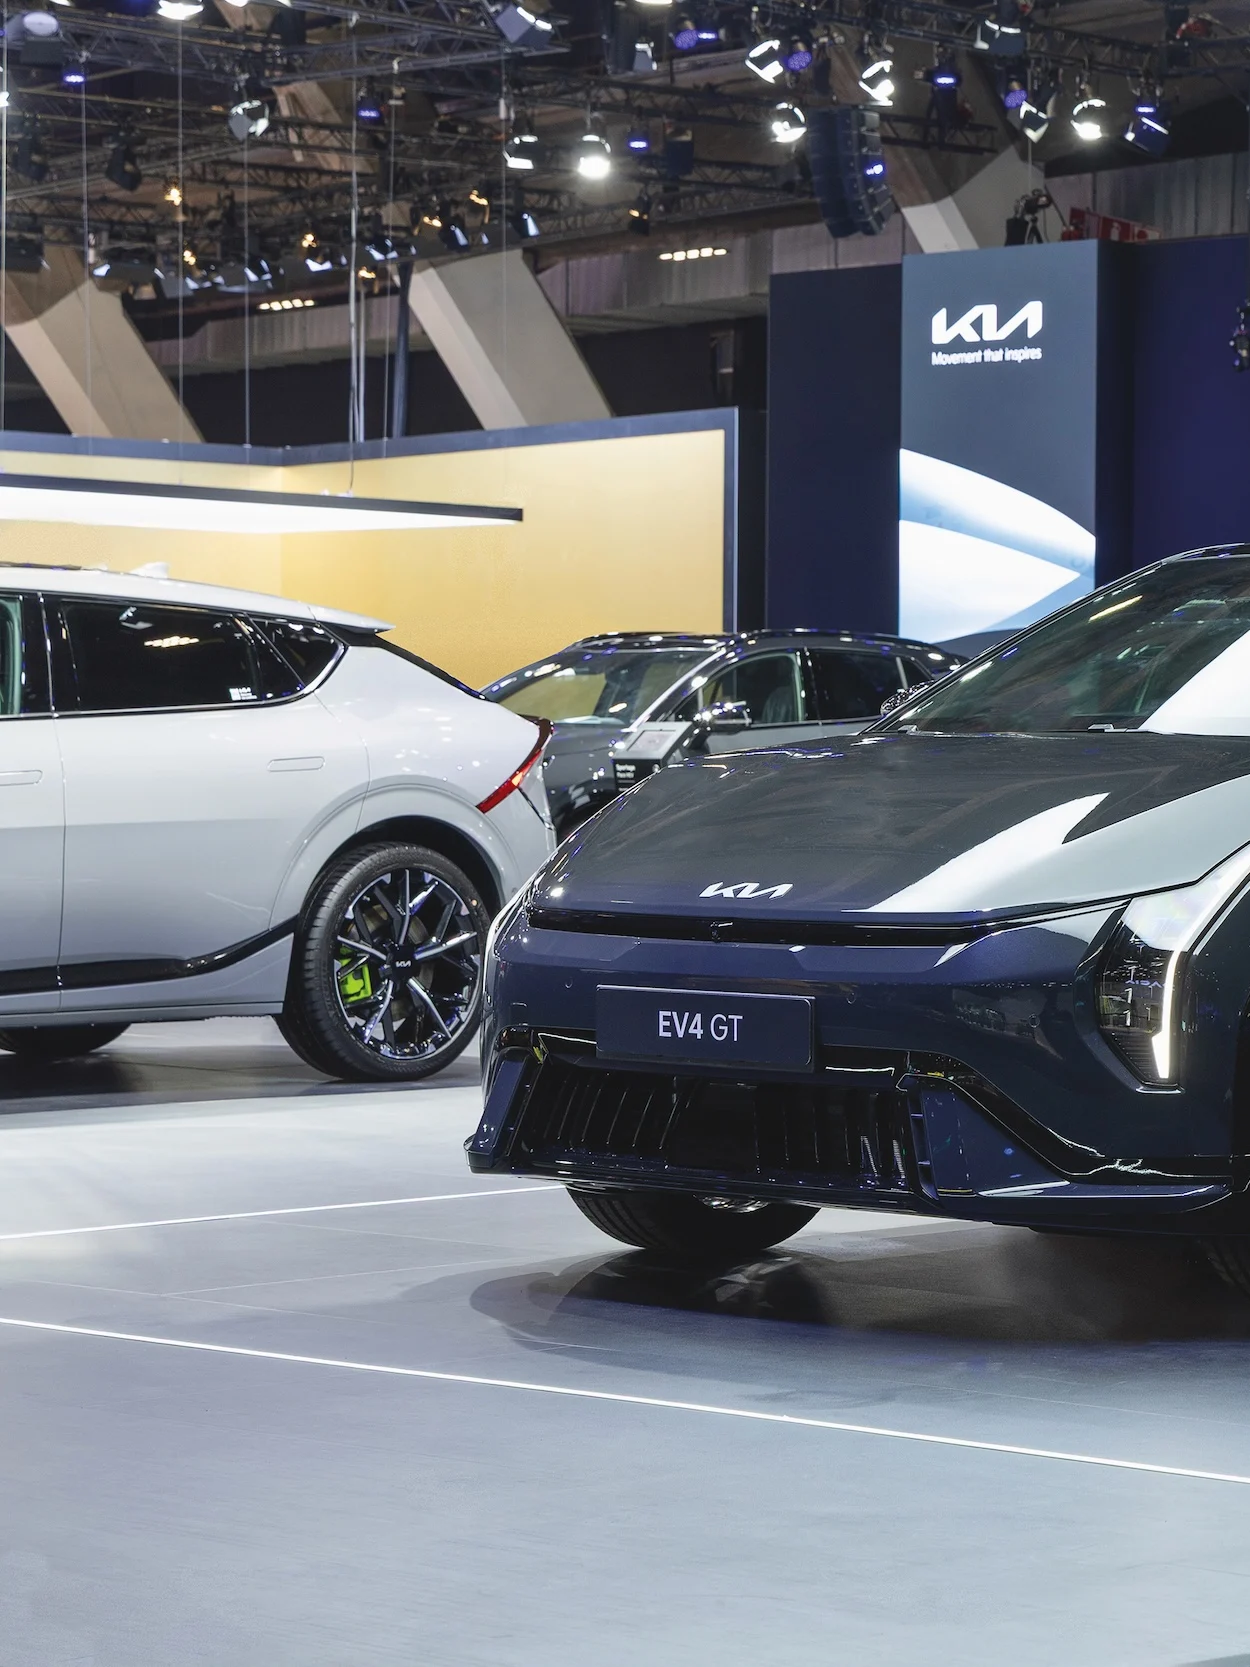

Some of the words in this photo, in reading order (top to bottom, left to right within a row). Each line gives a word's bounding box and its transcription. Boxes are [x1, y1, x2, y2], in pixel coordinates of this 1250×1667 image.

[931, 300, 1043, 345] KIA
[931, 350, 983, 366] Movement
[699, 881, 794, 899] KIA
[658, 1010, 704, 1040] EV4
[710, 1013, 743, 1042] GT
